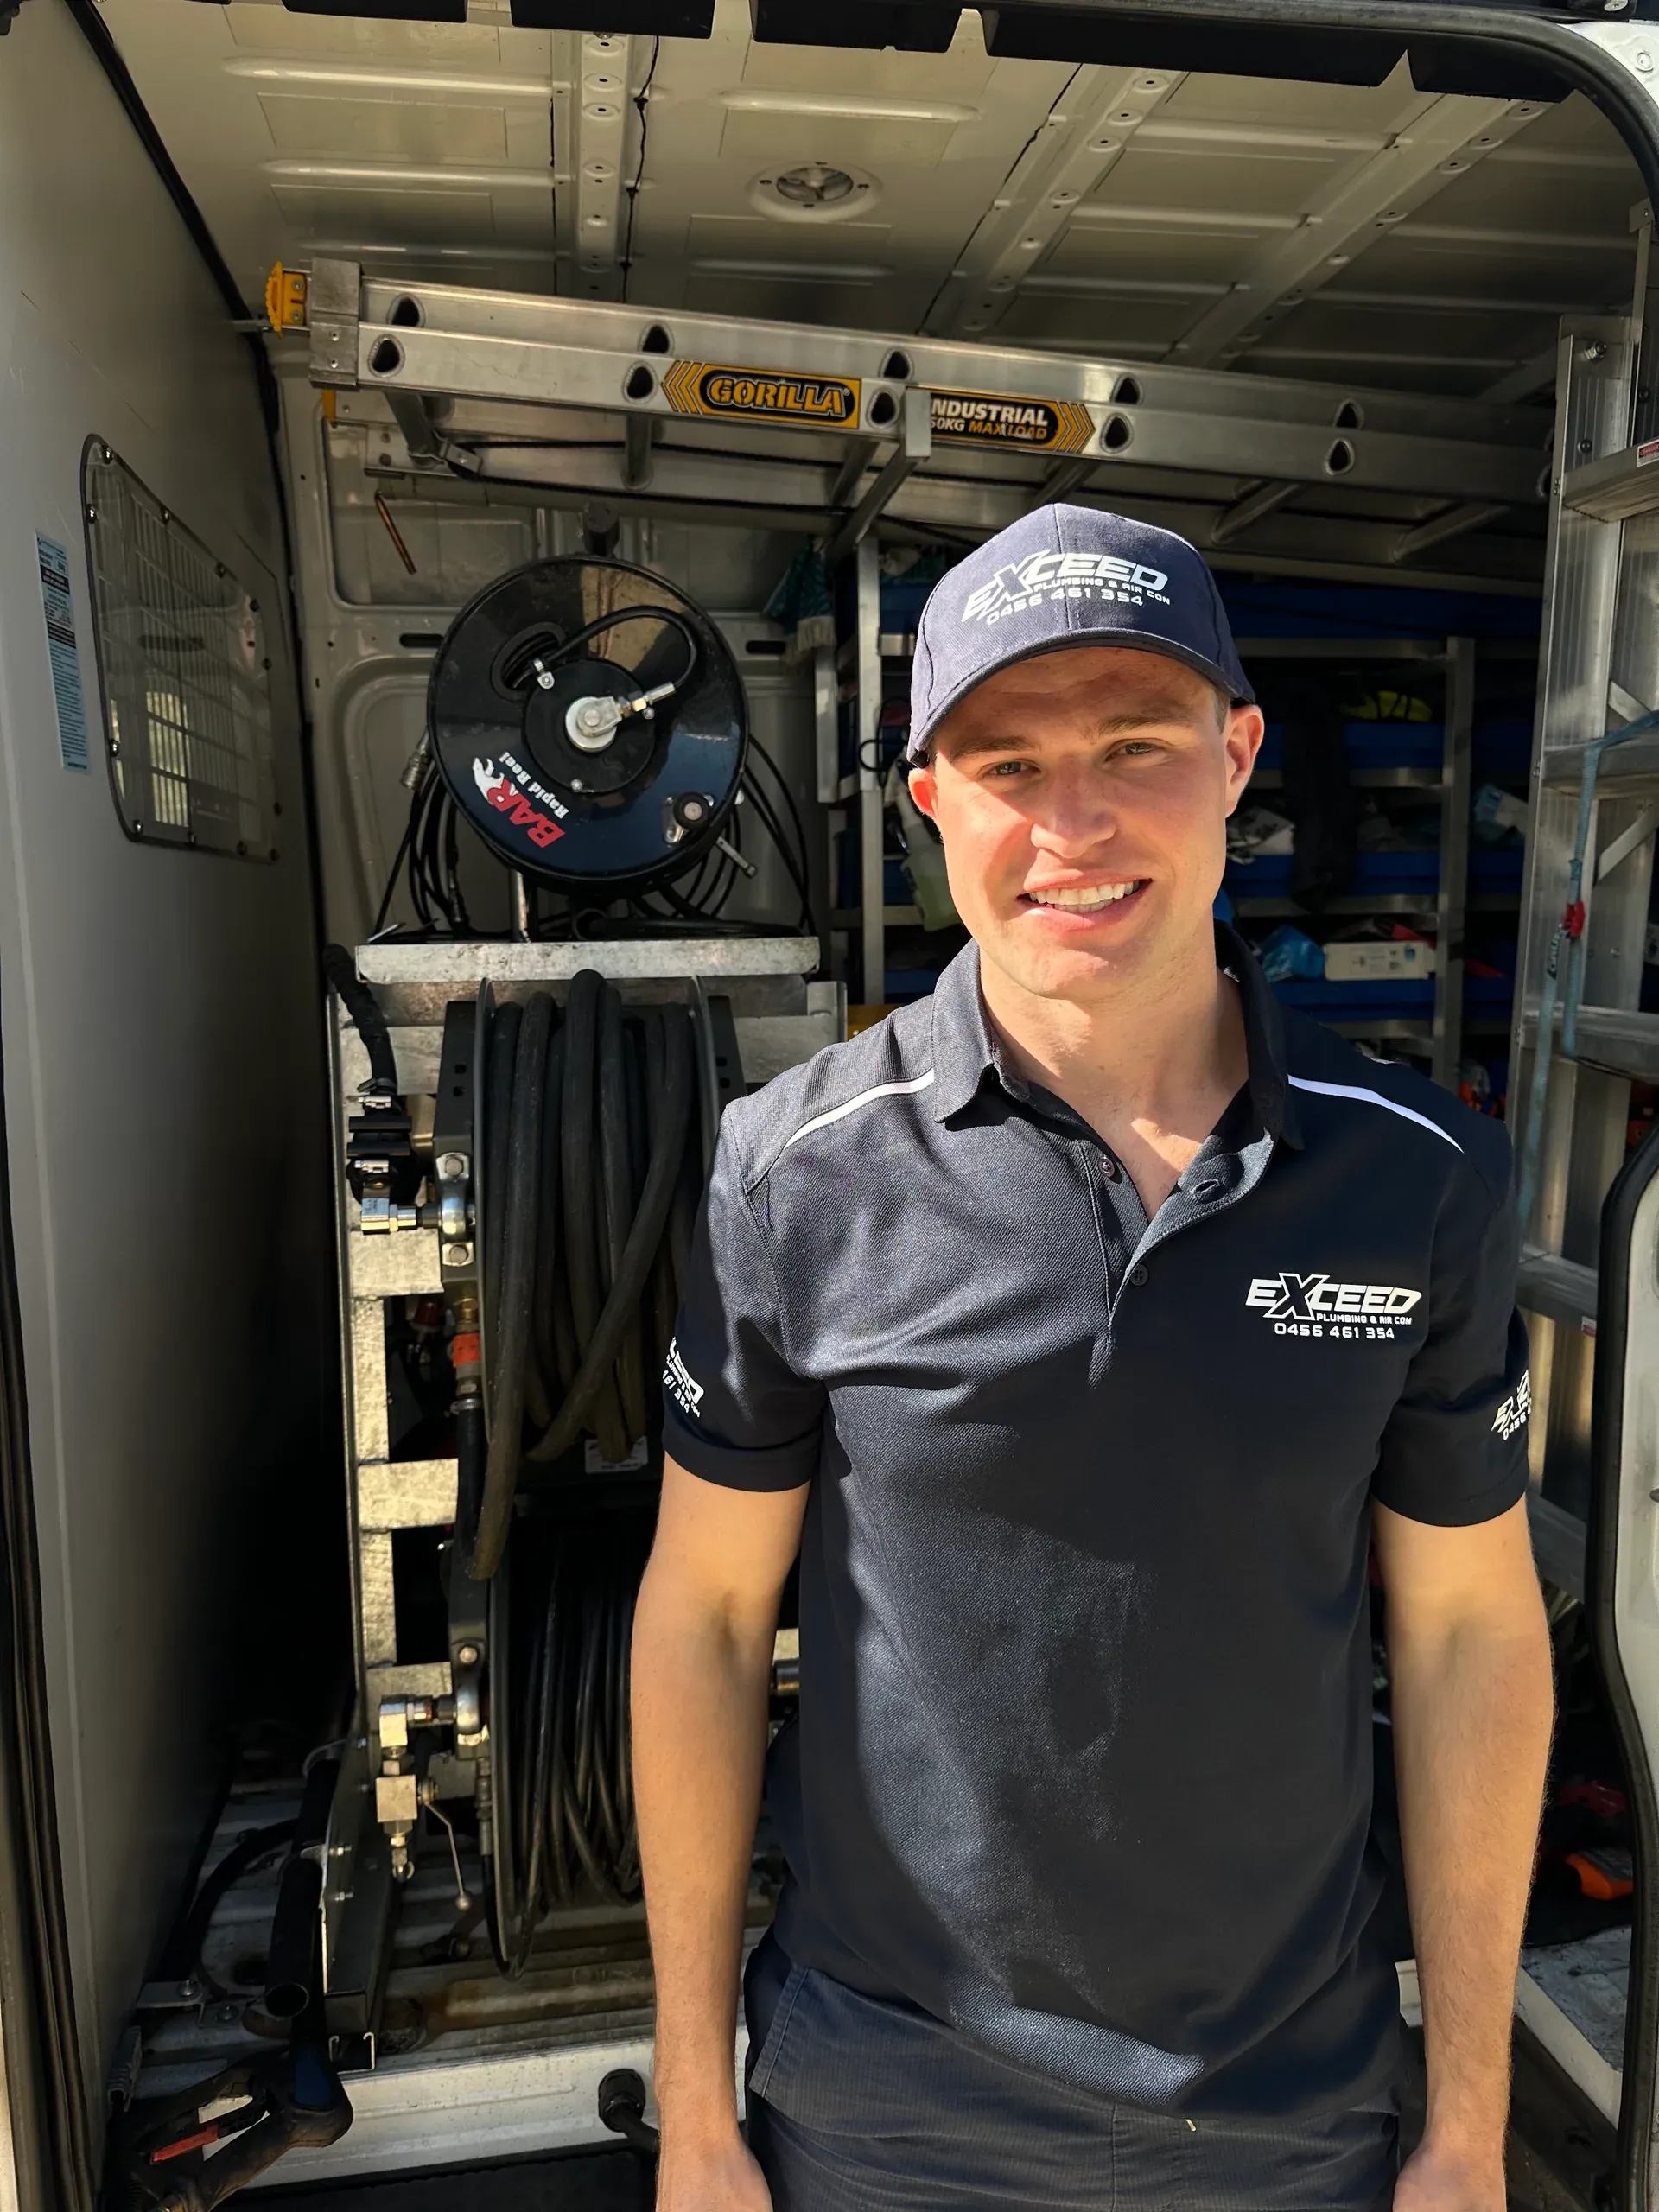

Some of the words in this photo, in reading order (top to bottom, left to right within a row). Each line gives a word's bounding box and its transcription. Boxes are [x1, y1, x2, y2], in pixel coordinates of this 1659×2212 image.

[708, 376, 846, 417] GORILLA
[931, 398, 1048, 426] NDUSTRIAL
[930, 417, 965, 431] 50KG
[969, 421, 1004, 435] MAX
[1008, 423, 1047, 440] LOAD
[962, 549, 1168, 623] EXCEED
[1033, 577, 1104, 593] PLUMBING
[1108, 580, 1118, 588] &
[1122, 583, 1143, 594] AIR
[1147, 590, 1171, 605] CON
[986, 593, 1042, 626] 0456
[1050, 589, 1091, 601] 461
[1101, 589, 1143, 607] 354
[499, 751, 531, 785] Reel
[486, 778, 566, 848] BAR
[527, 781, 569, 819] Rapid
[1245, 1272, 1422, 1321] EXCEED
[1274, 1323, 1323, 1337] 0456
[1329, 1325, 1359, 1338] 461
[1366, 1327, 1395, 1339] 354
[1316, 1313, 1368, 1324] PLUMBING
[1370, 1315, 1377, 1324] &
[1379, 1316, 1393, 1325] AIR
[674, 1388, 690, 1414] 354
[1503, 1411, 1527, 1440] 0456
